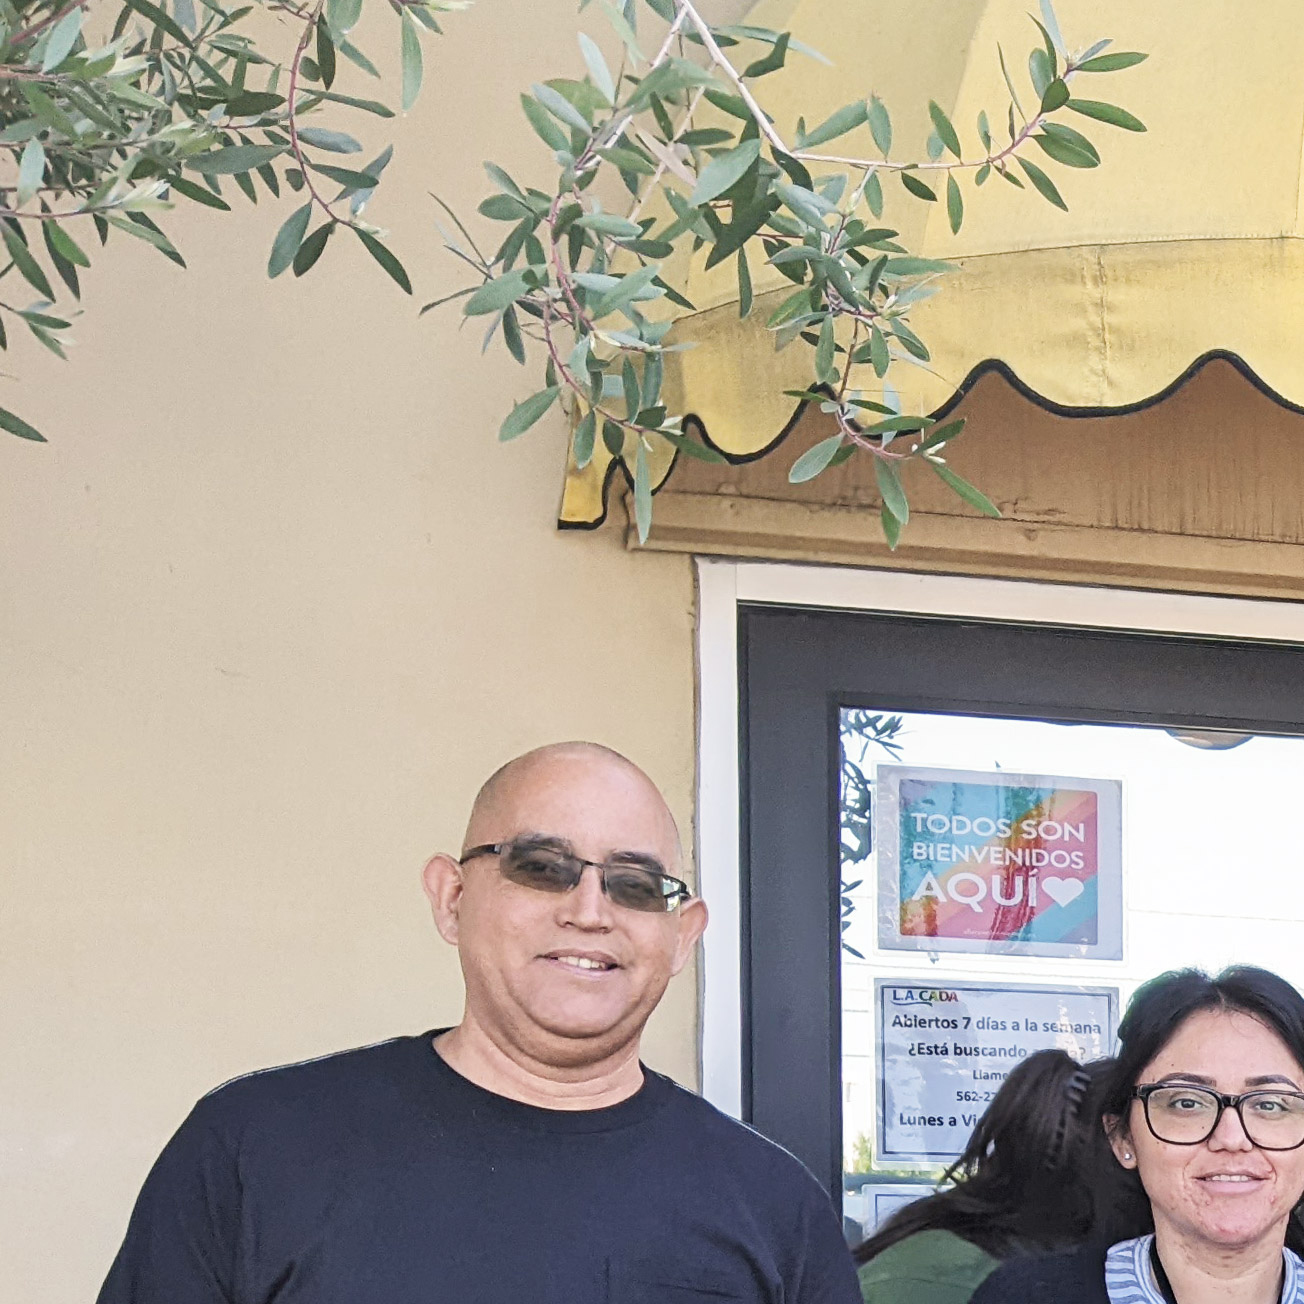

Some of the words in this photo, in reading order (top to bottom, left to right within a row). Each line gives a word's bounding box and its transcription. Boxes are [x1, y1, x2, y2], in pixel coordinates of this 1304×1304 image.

[910, 812, 1012, 838] TODOS
[1021, 819, 1085, 843] SON
[912, 842, 1085, 870] BIENVENIDOS
[911, 869, 1040, 913] AQUÍ
[891, 1014, 958, 1030] Abiertos
[962, 1016, 972, 1030] 7
[975, 1015, 1007, 1031] días
[1011, 1020, 1021, 1032] a
[1024, 1017, 1038, 1032] la
[1042, 1021, 1102, 1035] semana
[908, 1042, 949, 1057] ¿Está
[953, 1042, 1028, 1058] buscando
[899, 1112, 944, 1127] Lunes
[948, 1117, 957, 1127] a
